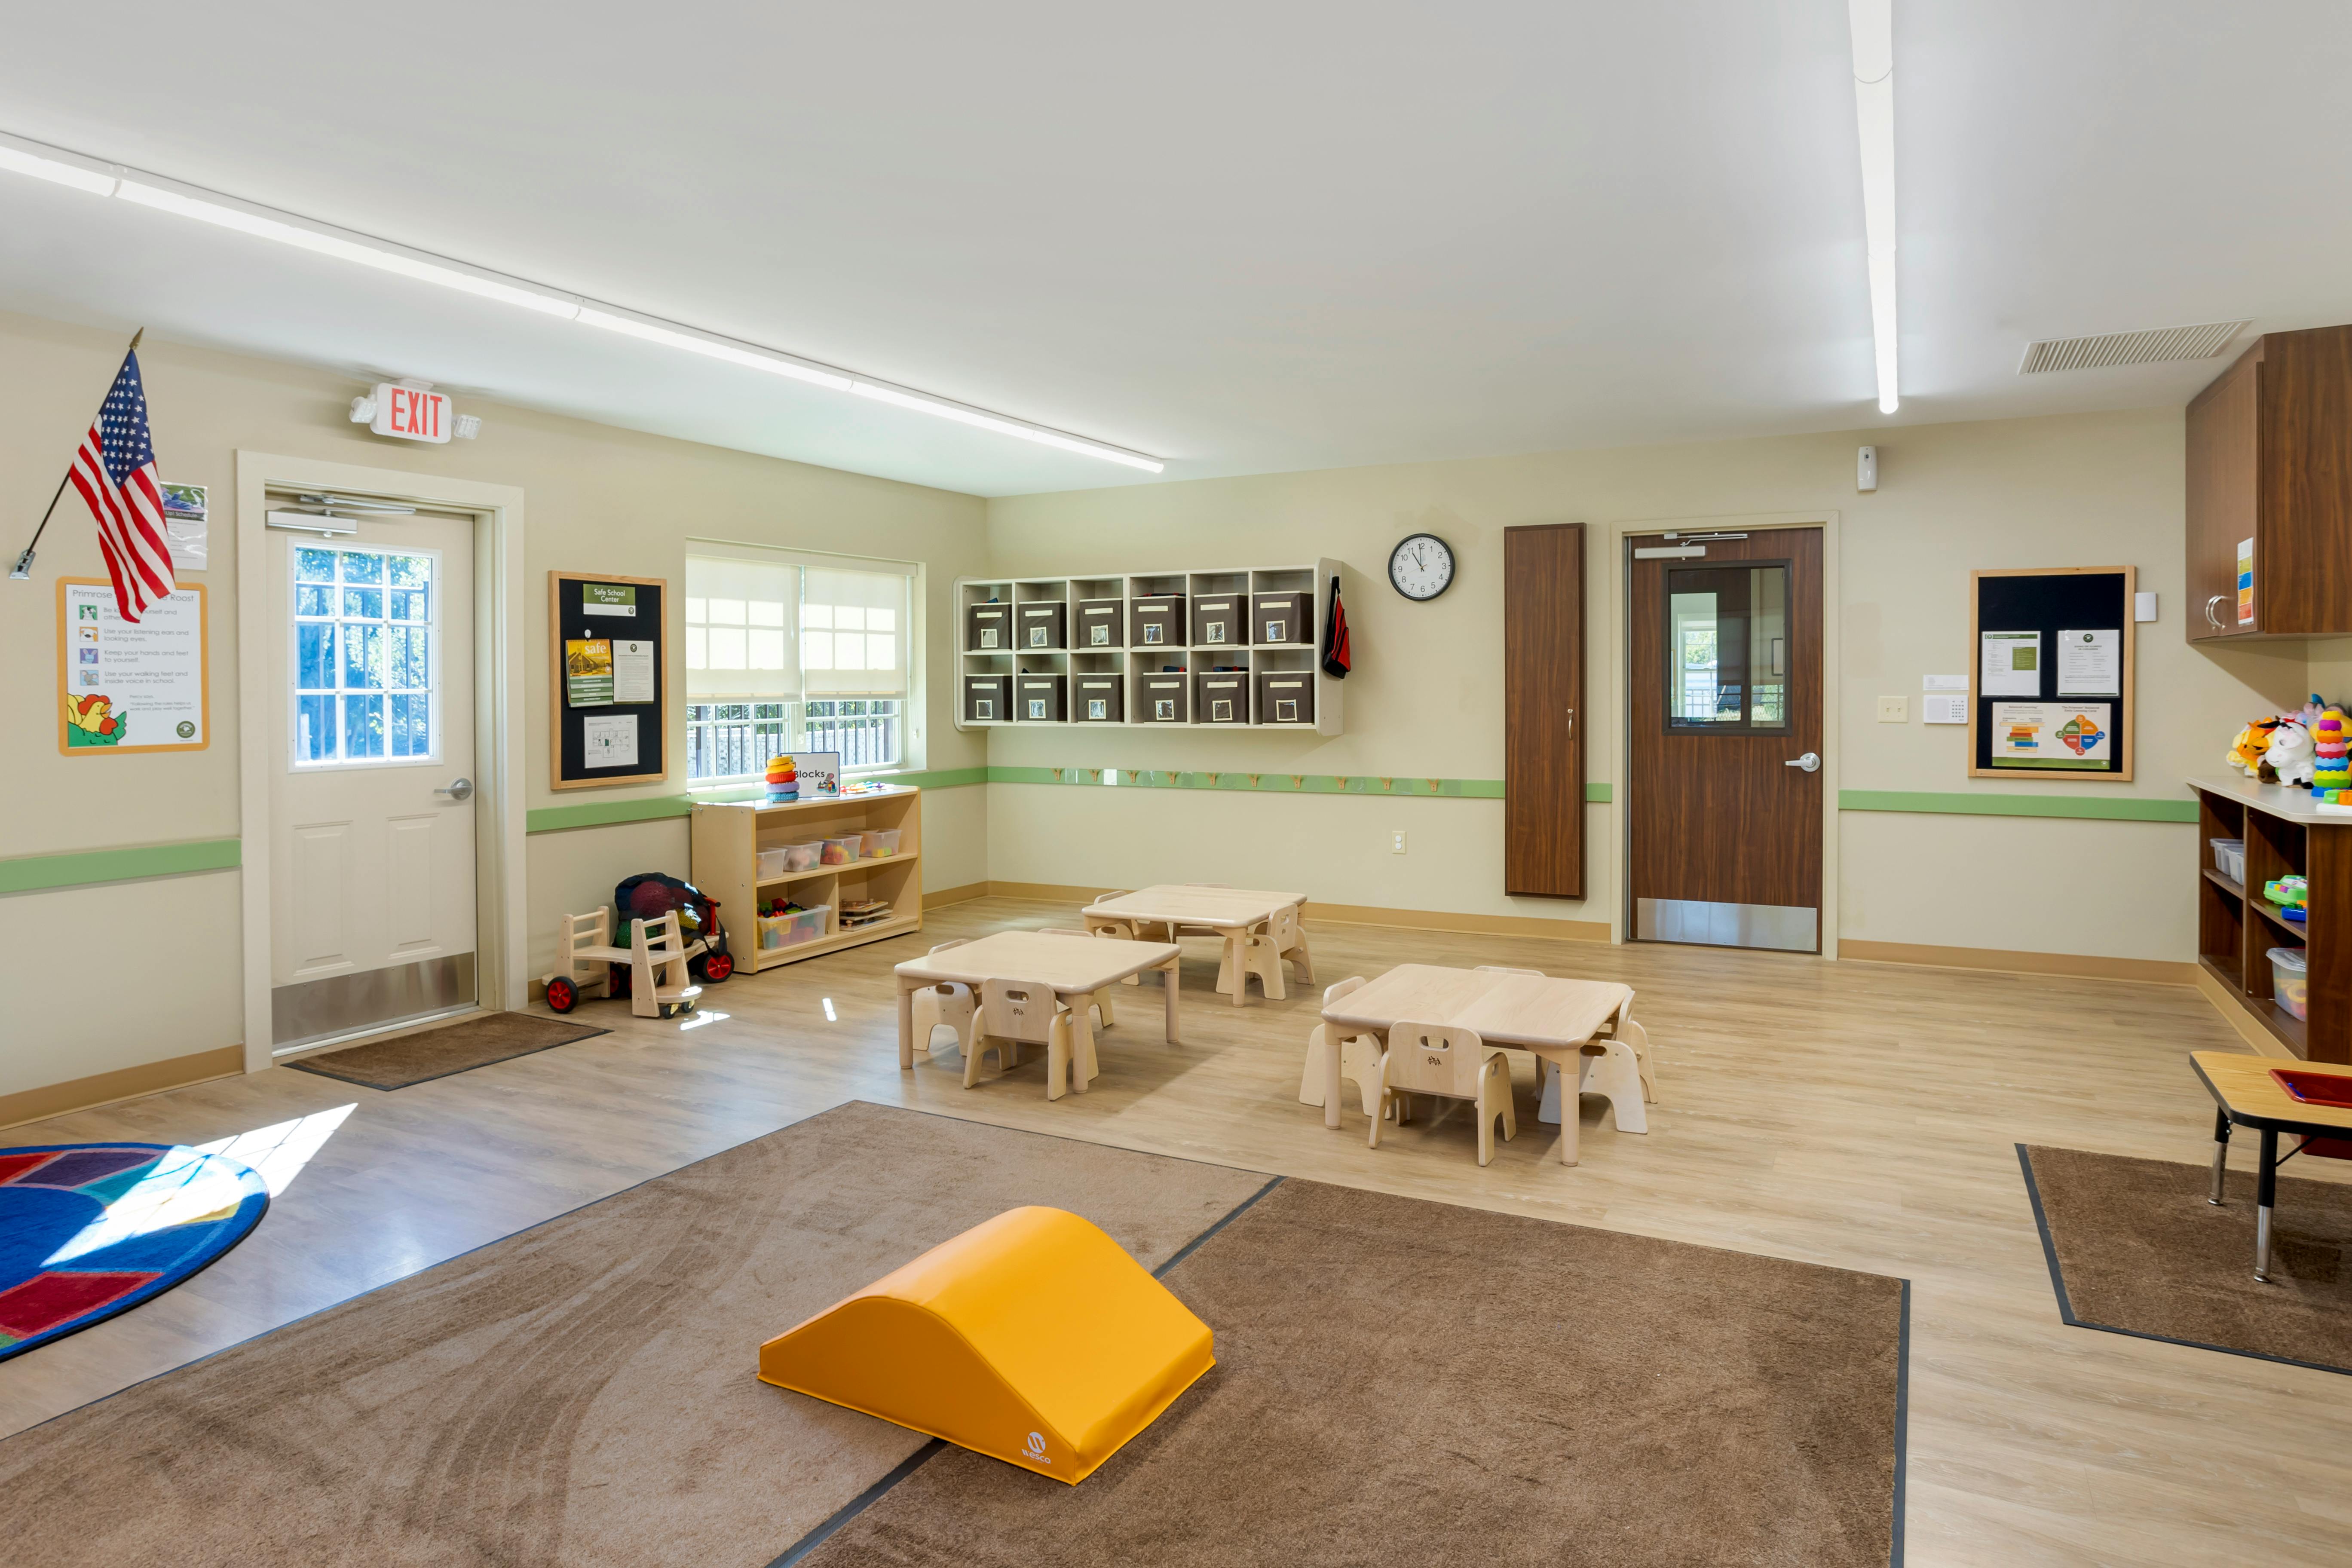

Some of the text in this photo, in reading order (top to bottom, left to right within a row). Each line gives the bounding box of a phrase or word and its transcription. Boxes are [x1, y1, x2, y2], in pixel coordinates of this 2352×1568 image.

[392, 388, 442, 437] EXIT
[73, 589, 112, 598] Primrose
[585, 642, 606, 654] safe
[795, 769, 825, 778] Blocks
